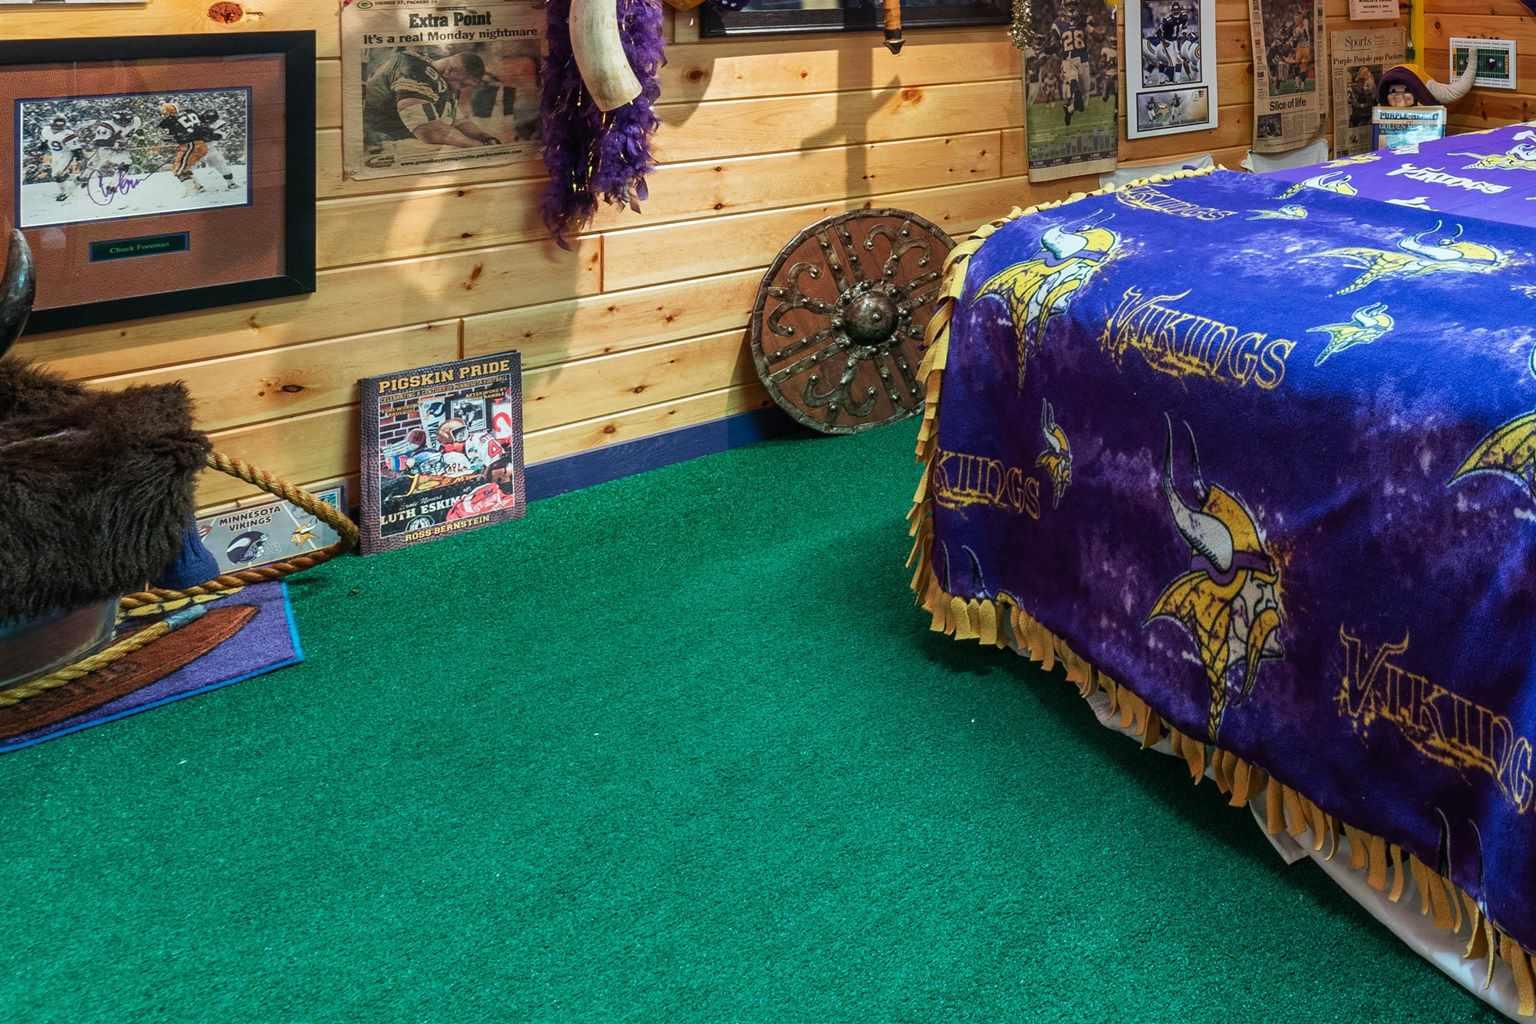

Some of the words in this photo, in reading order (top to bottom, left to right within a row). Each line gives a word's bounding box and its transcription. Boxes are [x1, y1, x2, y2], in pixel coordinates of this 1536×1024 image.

[409, 13, 449, 28] Extra
[453, 11, 492, 28] Point
[363, 34, 383, 45] It's
[387, 35, 395, 44] a
[399, 31, 423, 43] real
[427, 30, 476, 42] Monday
[478, 27, 537, 40] nightmare
[1061, 30, 1086, 52] 28
[1344, 36, 1373, 49] Sports
[1333, 56, 1353, 65] Purple
[1354, 54, 1372, 64] People
[1270, 100, 1286, 112] Slice
[1288, 98, 1295, 108] of
[1388, 163, 1511, 195] VIKINGS
[1098, 285, 1297, 391] VIKINGS
[379, 369, 454, 394] PIGSKIN
[459, 360, 511, 379] PRIDE
[219, 505, 282, 527] MINNESOTA
[228, 516, 273, 532] VIKINGS
[380, 508, 416, 526] LUTH
[405, 530, 432, 543] ROSS
[434, 515, 491, 534] BERNSTEIN
